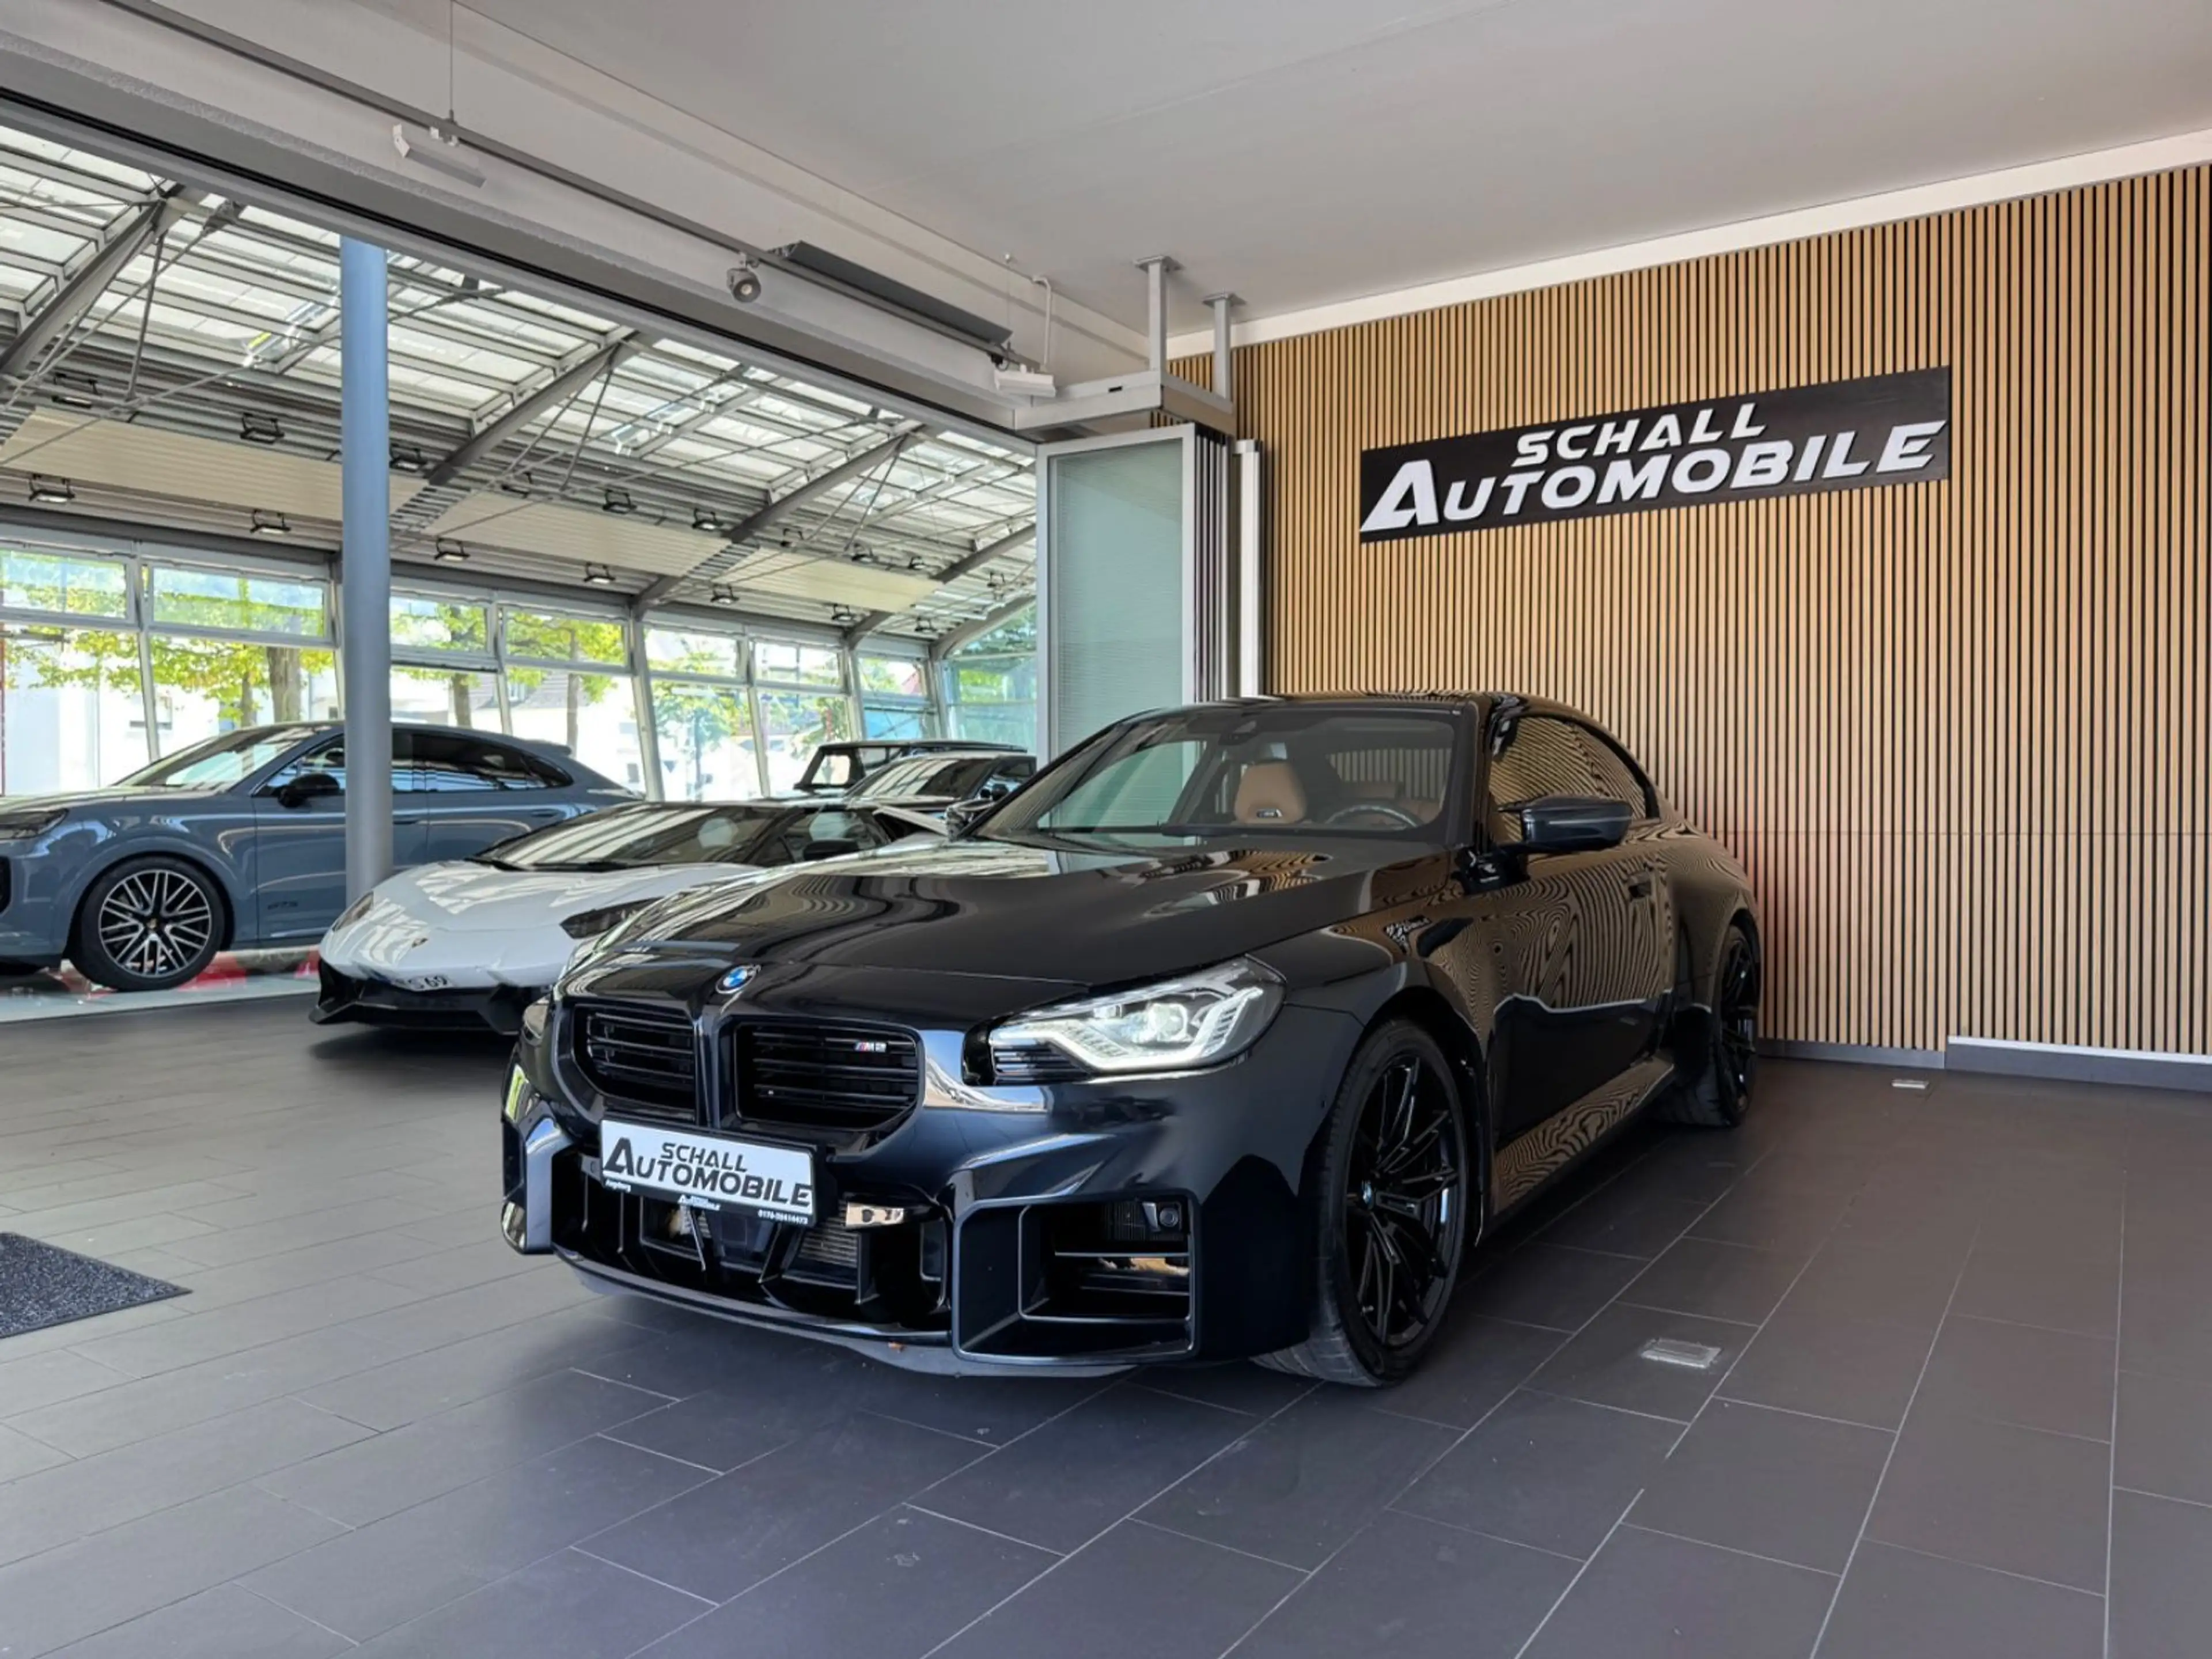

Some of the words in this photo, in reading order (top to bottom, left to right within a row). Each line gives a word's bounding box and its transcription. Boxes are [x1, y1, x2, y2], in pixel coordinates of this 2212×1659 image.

[1511, 402, 1768, 467] SCHALL
[1359, 419, 1948, 533] AUTOMOBILE
[604, 1137, 813, 1207] AUTOMOBILE
[661, 1142, 747, 1172] SCHALL
